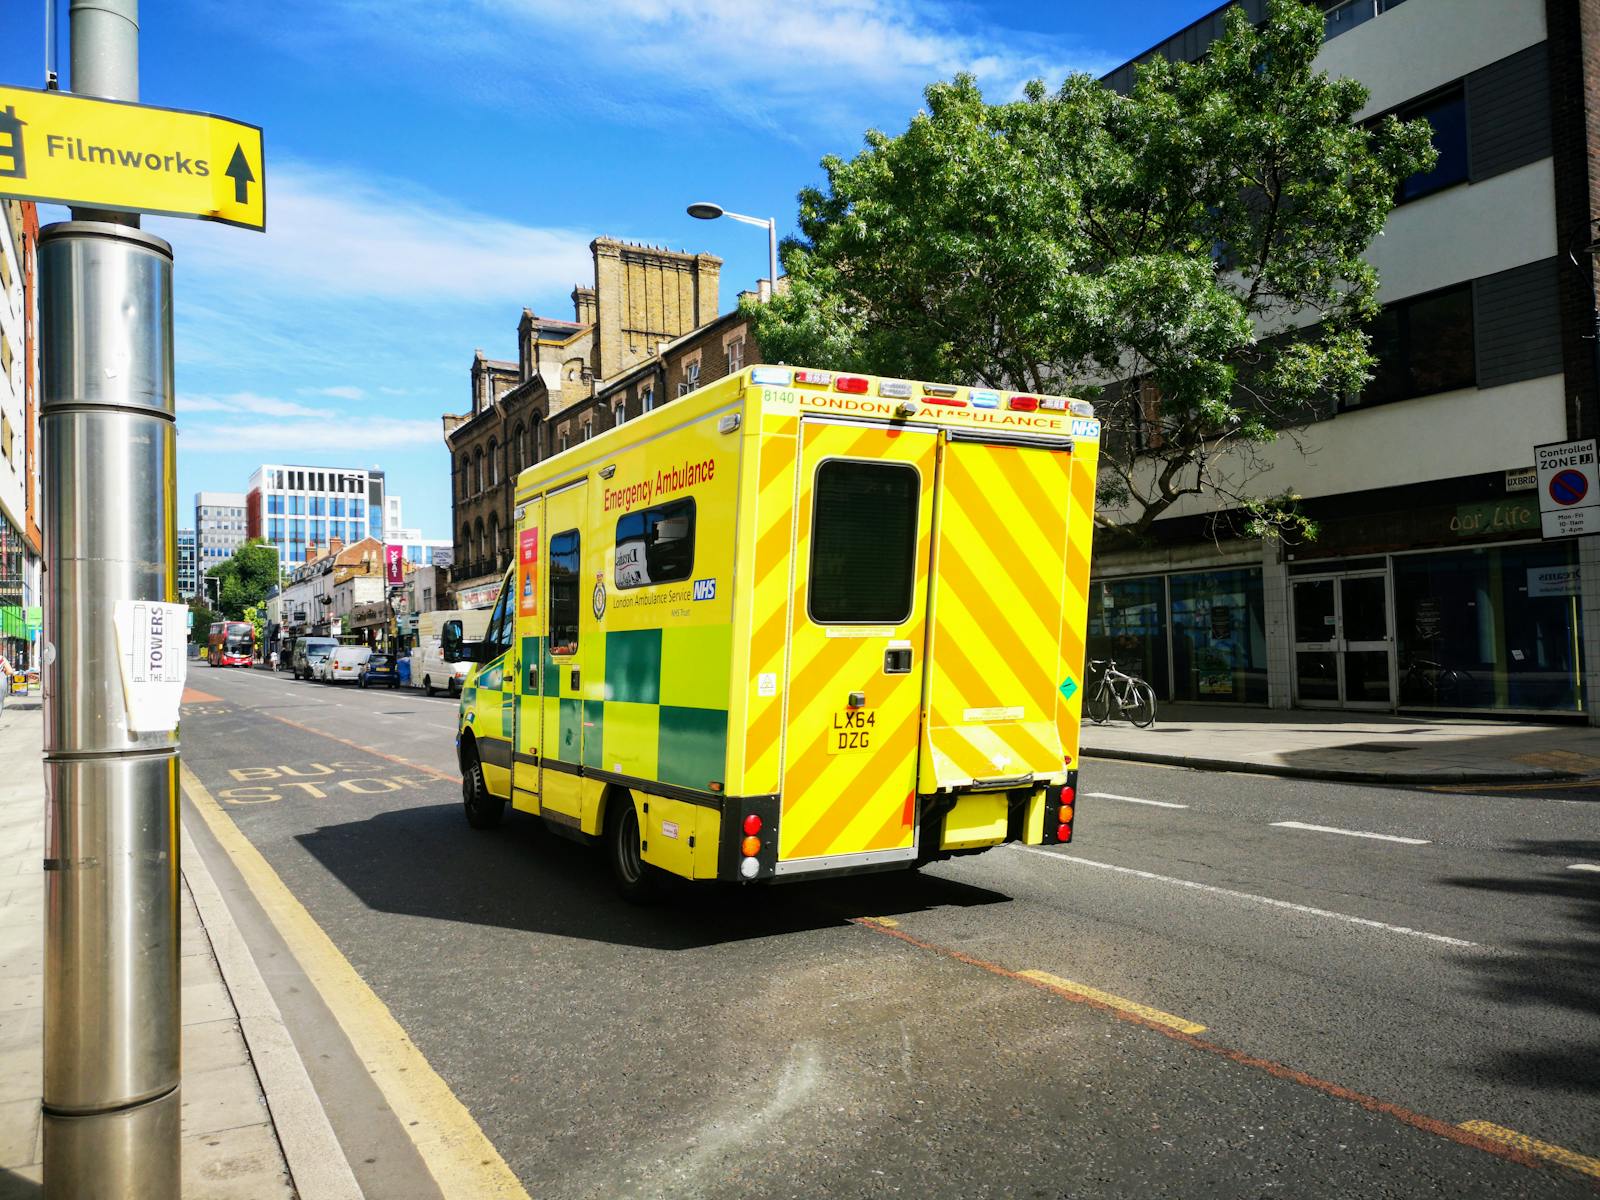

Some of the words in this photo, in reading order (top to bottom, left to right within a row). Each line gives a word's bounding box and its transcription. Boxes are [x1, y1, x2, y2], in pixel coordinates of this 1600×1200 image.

[46, 134, 210, 177] Filmworks
[764, 389, 794, 404] 8140
[800, 395, 890, 414] LONDON
[1072, 419, 1098, 437] NHS
[1540, 443, 1593, 458] Controlled
[1540, 456, 1577, 470] ZONE
[604, 479, 654, 512] Emergency
[655, 458, 715, 496] Ambulance
[613, 596, 634, 609] London
[635, 593, 667, 606] Ambulance
[668, 590, 691, 603] Service
[694, 579, 716, 601] NHS
[150, 607, 164, 671] TOWERS
[149, 673, 163, 682] THE
[834, 711, 875, 729] LX64
[838, 731, 870, 749] DZG
[227, 760, 386, 782] BUS
[218, 774, 443, 805] STOP
